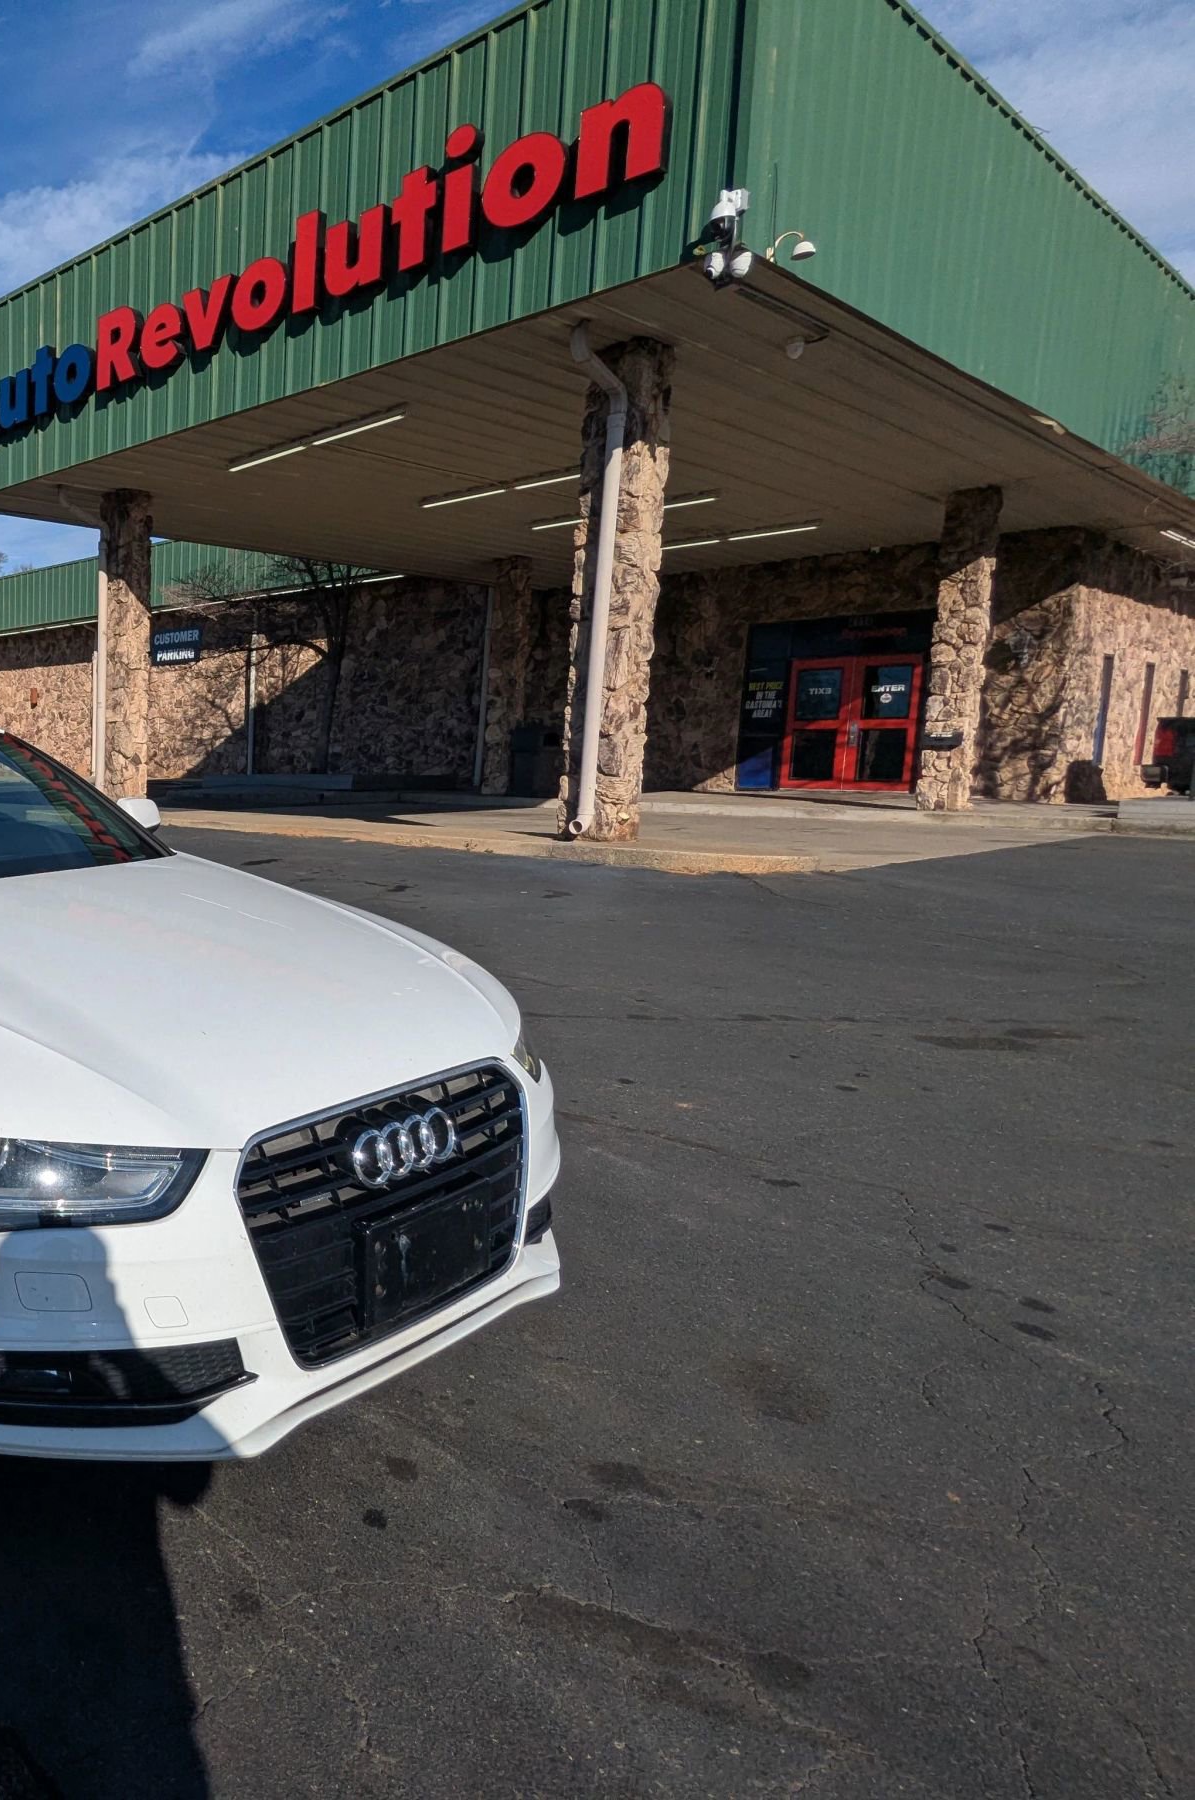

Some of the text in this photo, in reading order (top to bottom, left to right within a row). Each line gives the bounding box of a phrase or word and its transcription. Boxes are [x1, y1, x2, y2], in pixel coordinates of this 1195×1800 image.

[154, 629, 200, 646] CUSTOMER
[156, 648, 195, 662] PARKING
[765, 681, 784, 690] PRICE
[871, 684, 906, 693] ENTER
